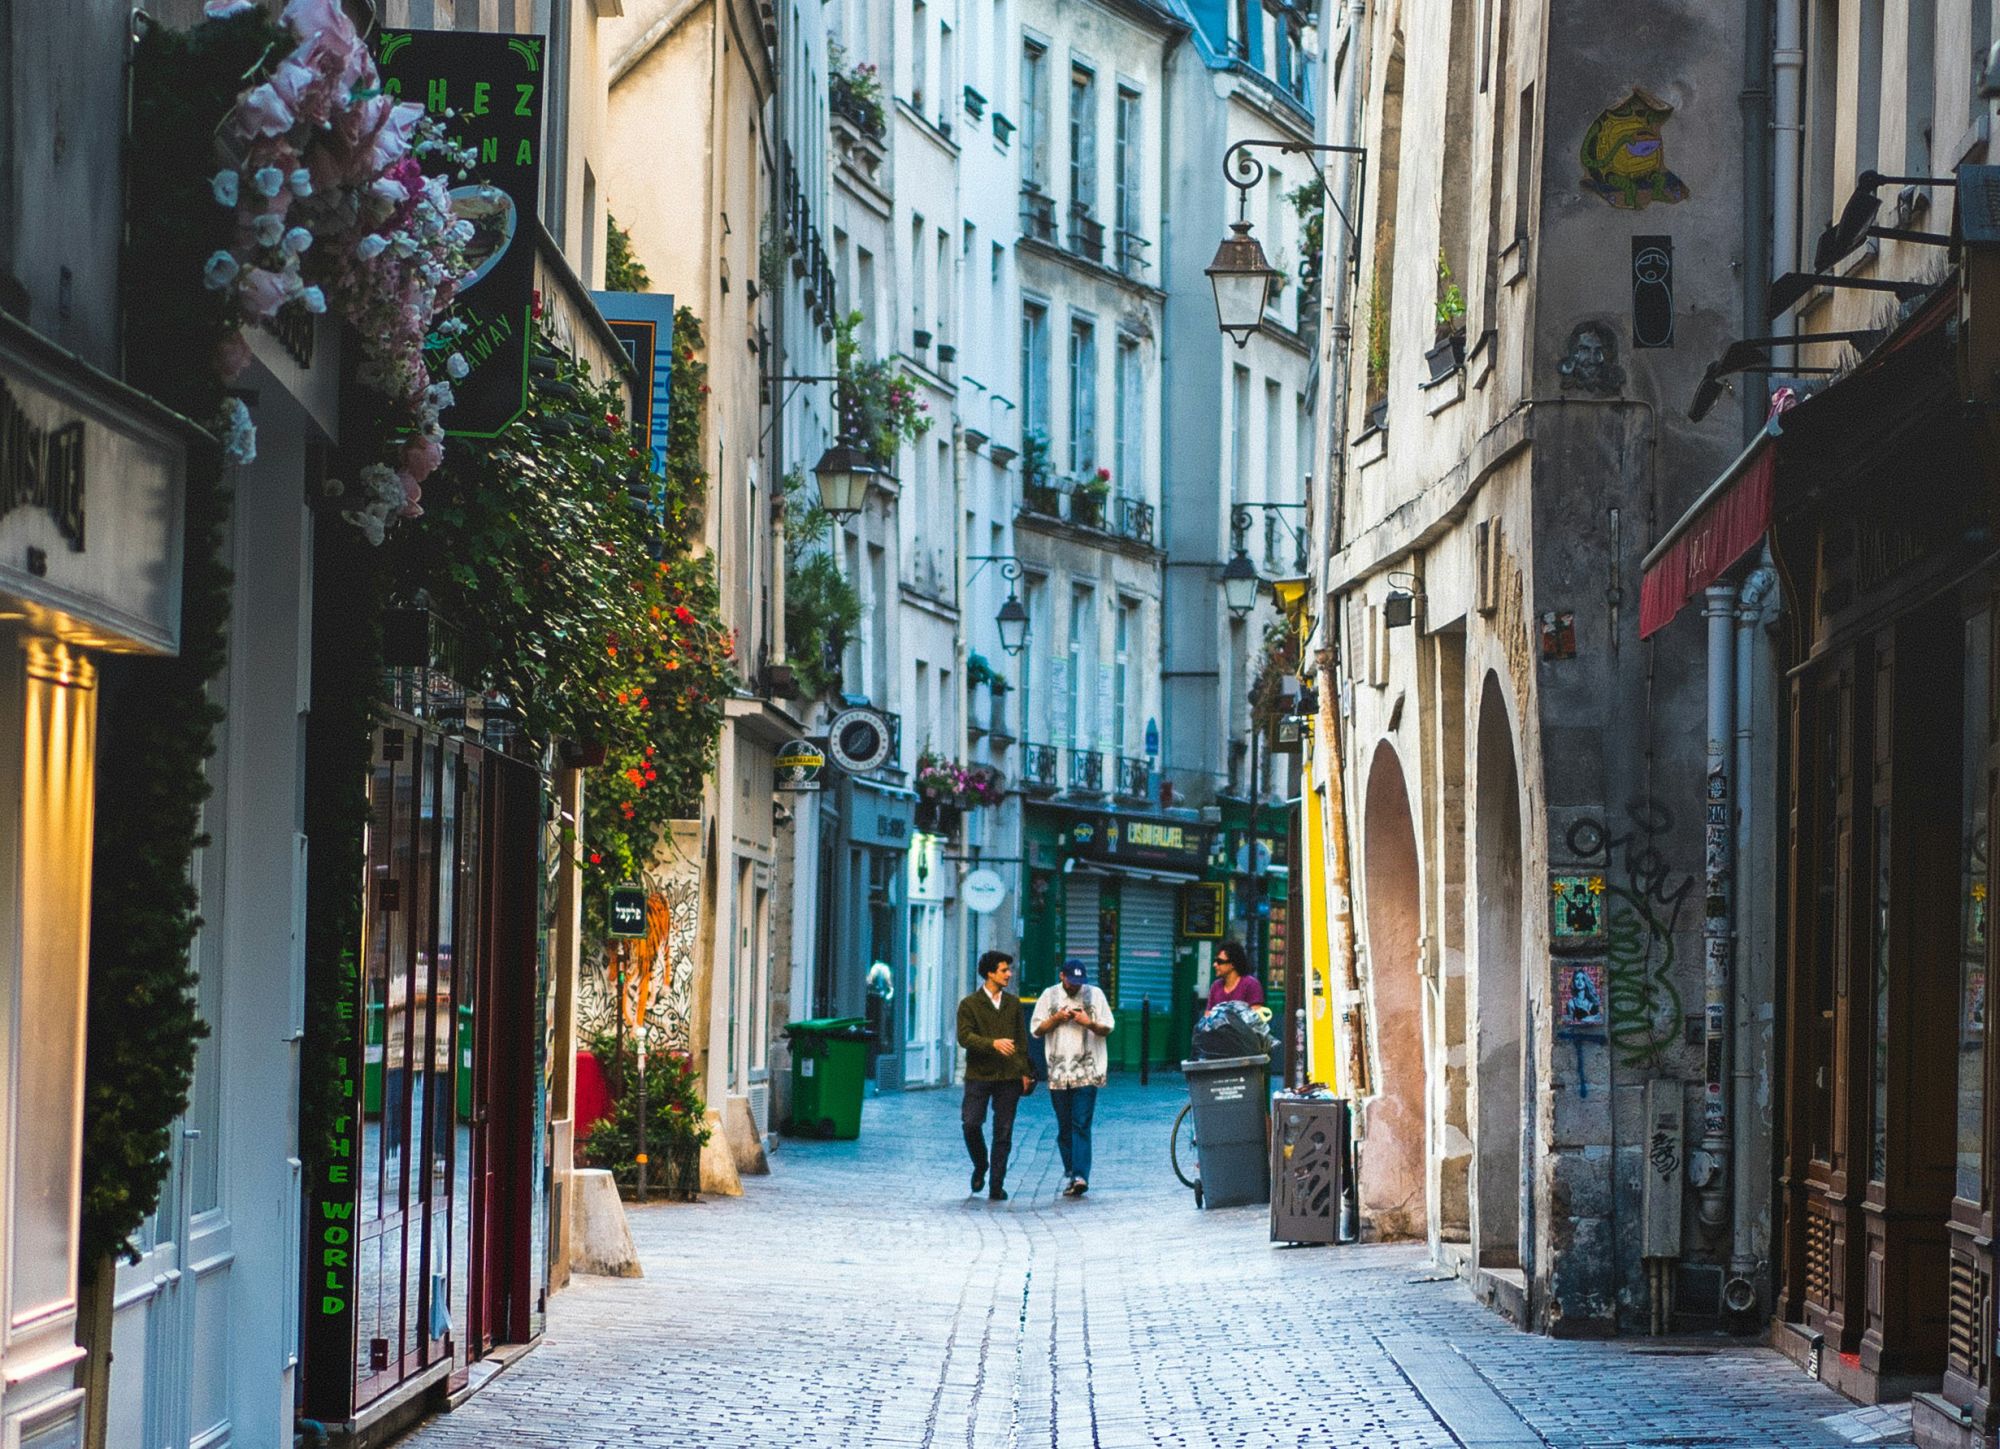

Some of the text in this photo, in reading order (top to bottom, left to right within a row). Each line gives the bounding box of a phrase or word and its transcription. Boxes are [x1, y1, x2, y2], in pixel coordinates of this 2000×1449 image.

[383, 76, 535, 117] CHEZ
[464, 312, 513, 373] AWAY
[321, 1201, 354, 1316] WORLD
